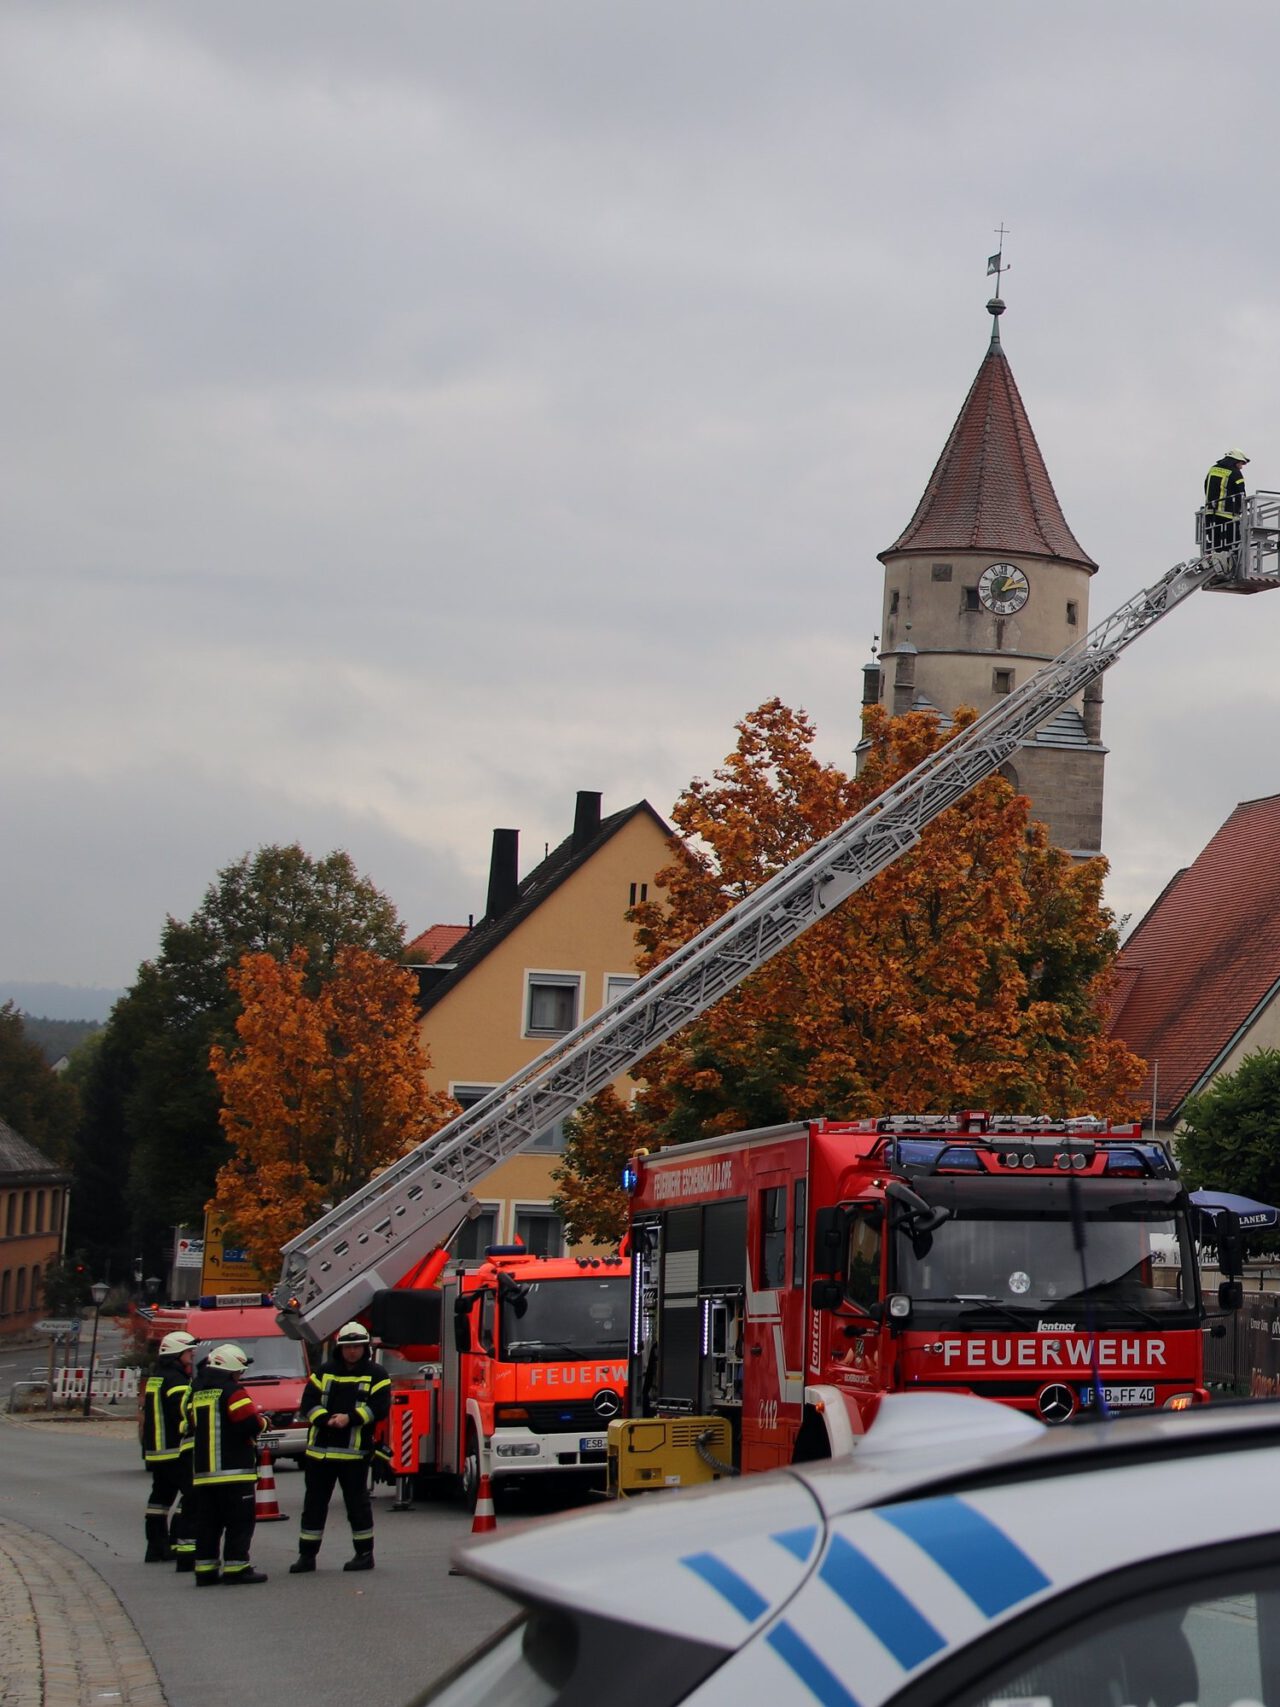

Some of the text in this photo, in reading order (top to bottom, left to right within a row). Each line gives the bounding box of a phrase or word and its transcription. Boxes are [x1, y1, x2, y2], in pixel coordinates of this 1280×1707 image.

[1239, 1213, 1268, 1225] LANER
[218, 1295, 260, 1306] FEUERWEHR
[1037, 1320, 1076, 1333] lentner
[944, 1339, 1167, 1366] FEUERWEHR
[530, 1366, 628, 1386] FEUERW
[1088, 1388, 1154, 1401] EB FF 40
[764, 1400, 778, 1430] 112
[586, 1439, 603, 1449] ESB
